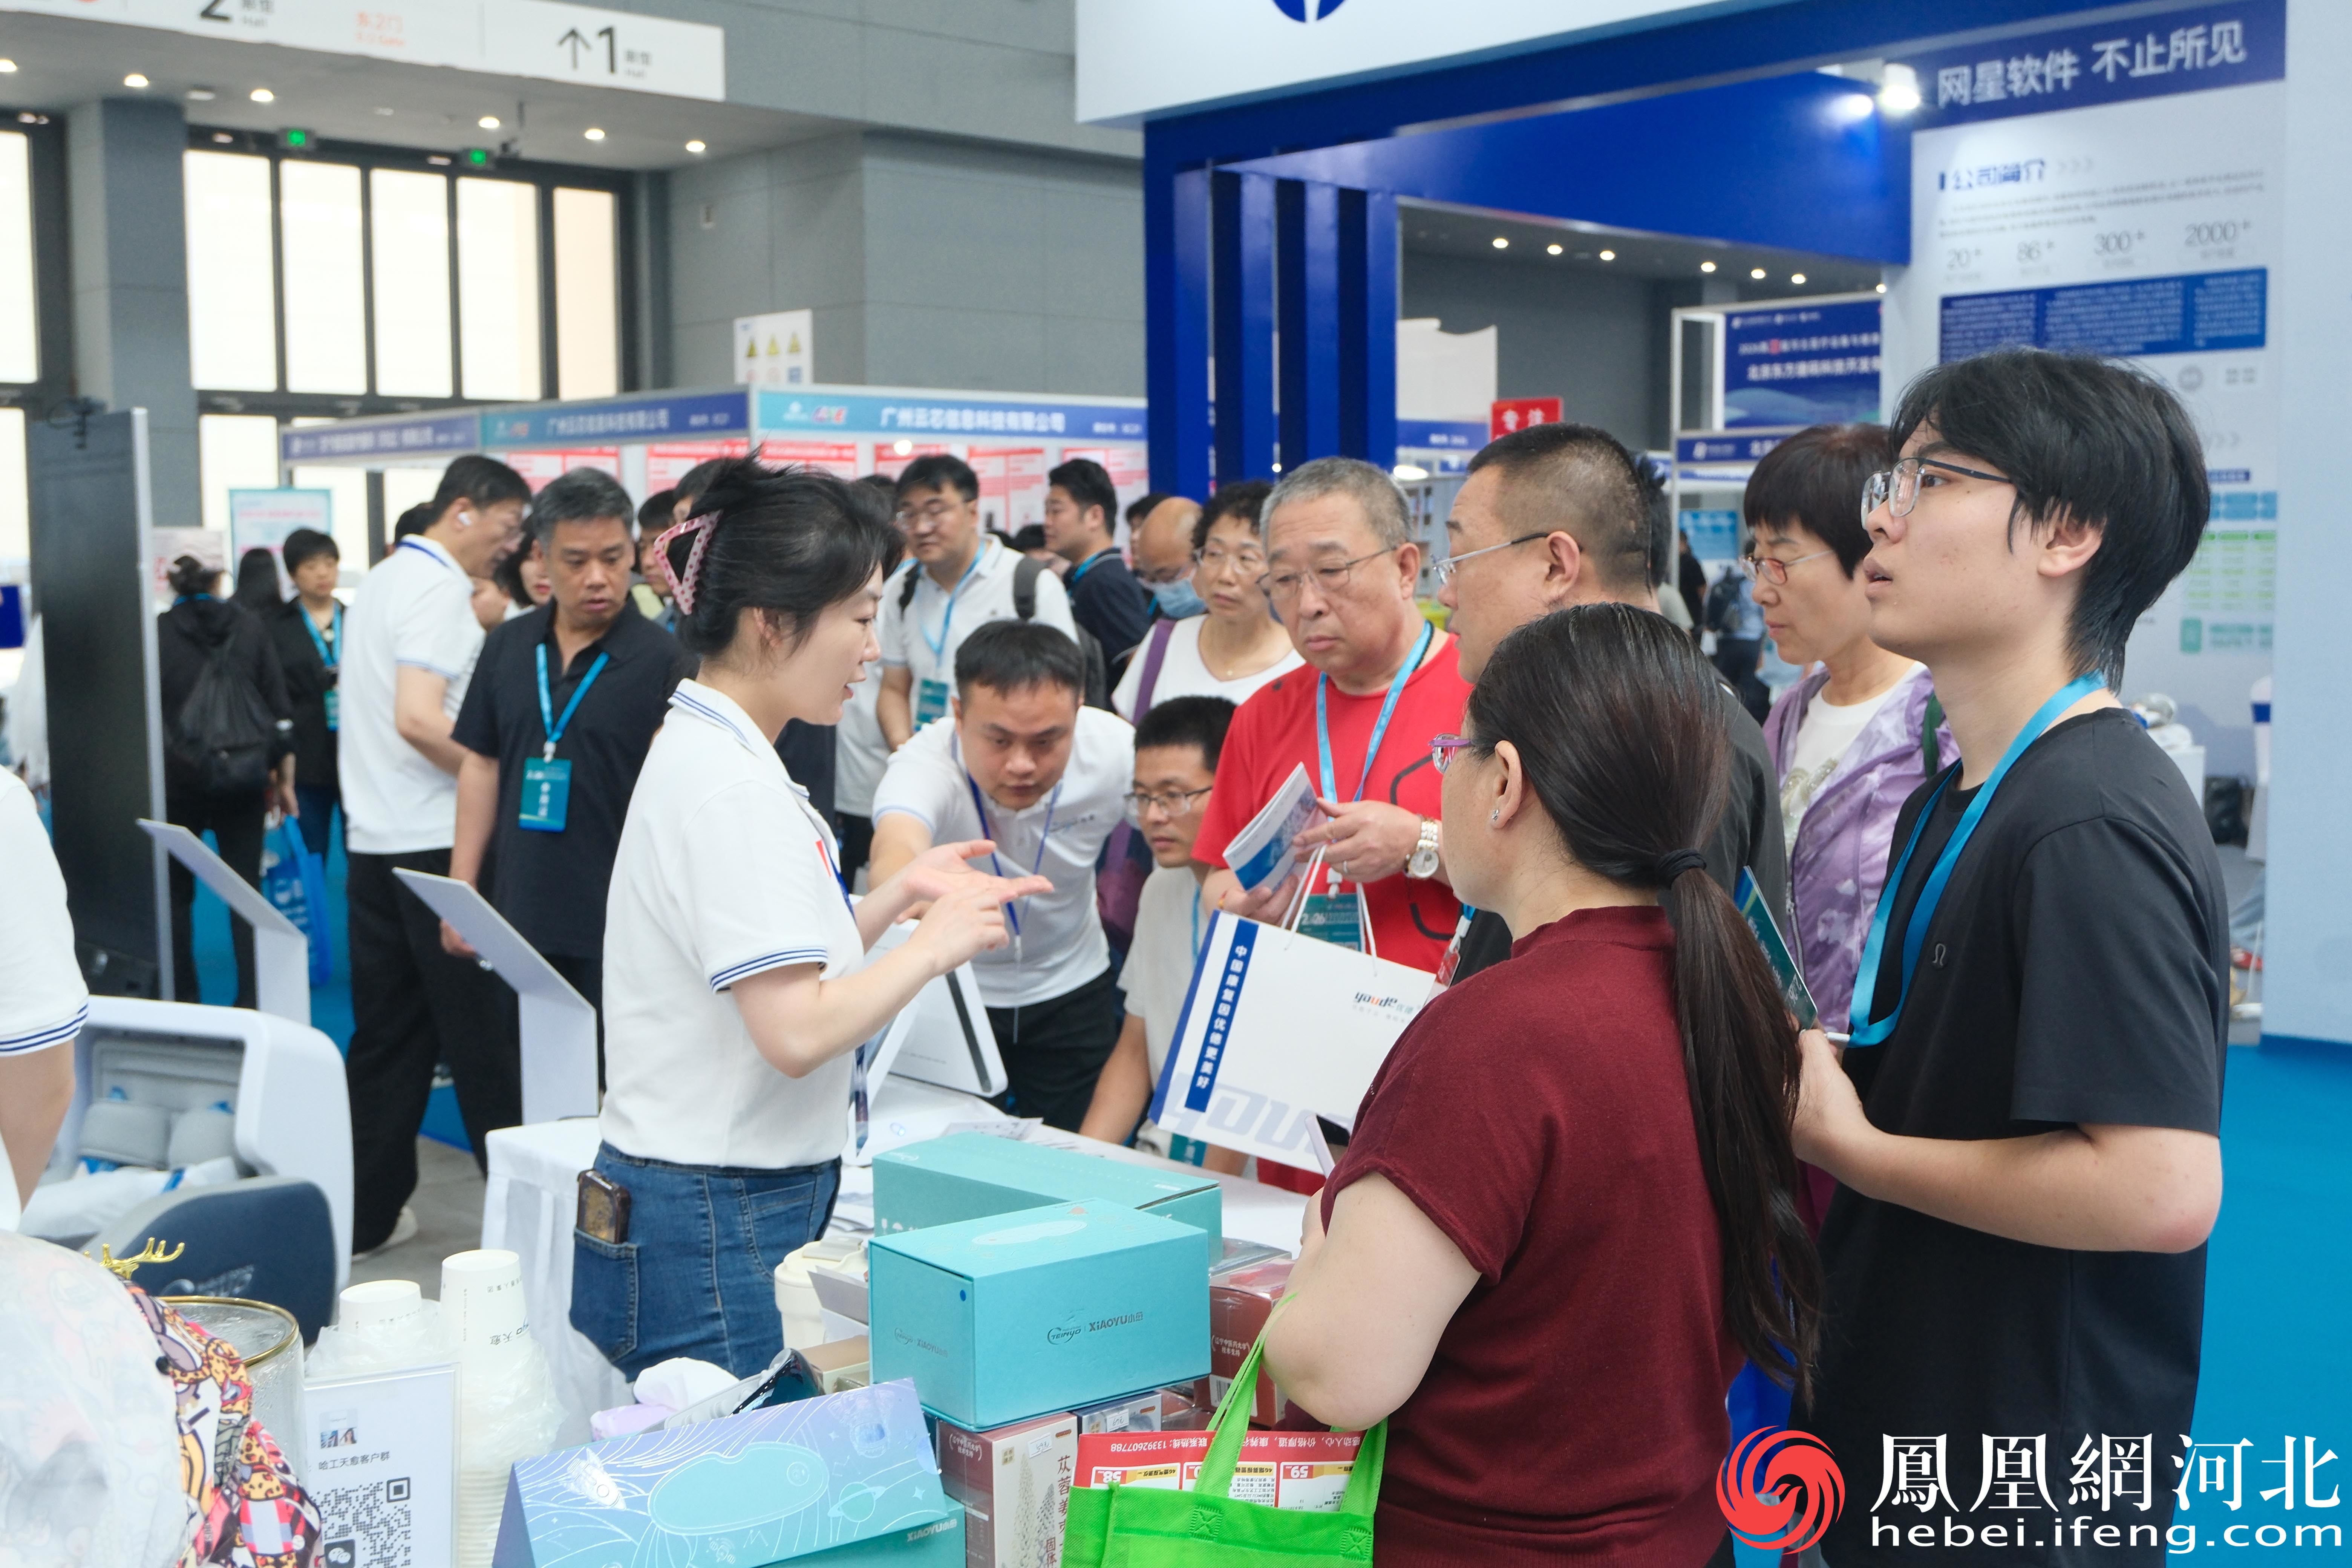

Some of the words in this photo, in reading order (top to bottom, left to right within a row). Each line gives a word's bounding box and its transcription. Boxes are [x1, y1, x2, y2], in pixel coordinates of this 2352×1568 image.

[598, 27, 615, 74] 1
[1937, 49, 2081, 109] 网星软件
[2092, 21, 2247, 82] 不止所见
[318, 1451, 390, 1470] 哈工天愈客户群
[1103, 1471, 1122, 1483] 58
[1290, 1466, 1309, 1478] 59
